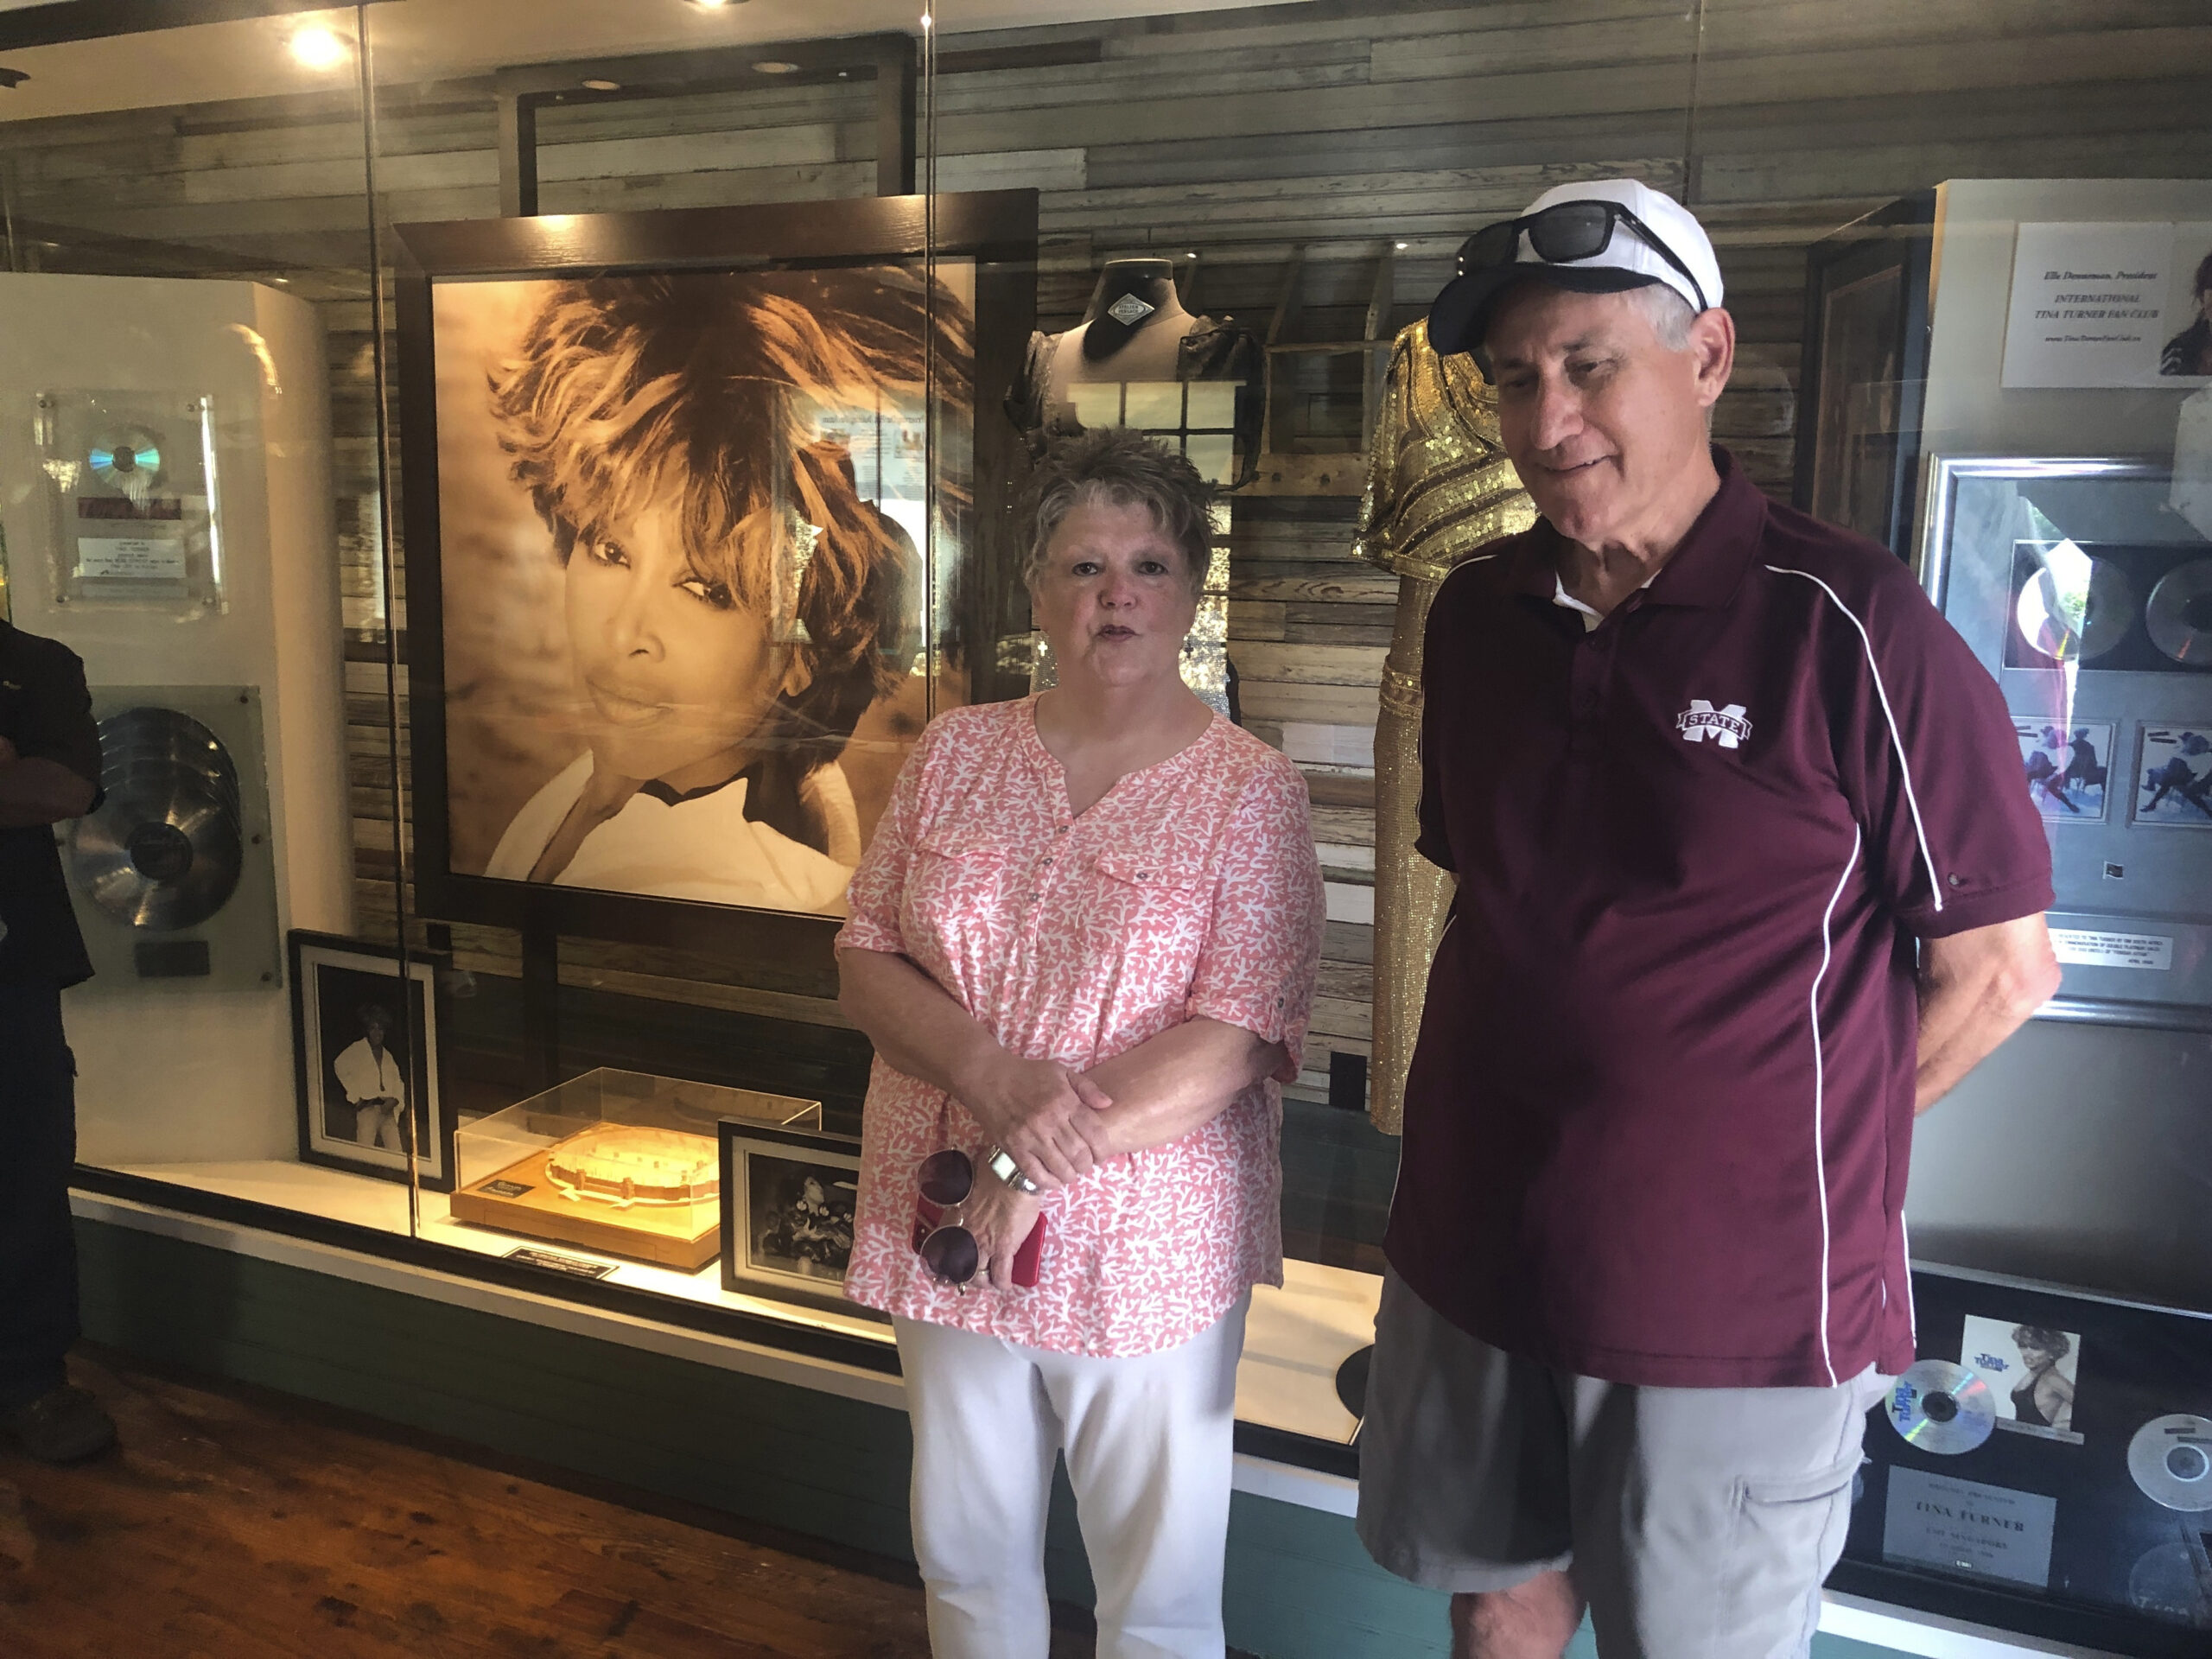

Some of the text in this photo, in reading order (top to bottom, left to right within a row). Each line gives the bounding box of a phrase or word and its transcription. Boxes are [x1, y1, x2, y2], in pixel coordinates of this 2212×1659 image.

[2055, 294, 2141, 303] INTERNATIONAL
[2035, 309, 2160, 319] TINA TURNER FAN CLUB
[1688, 713, 1740, 734] STATE
[1980, 1352, 2004, 1366] Tina
[1916, 1500, 2024, 1532] TINA TURNER
